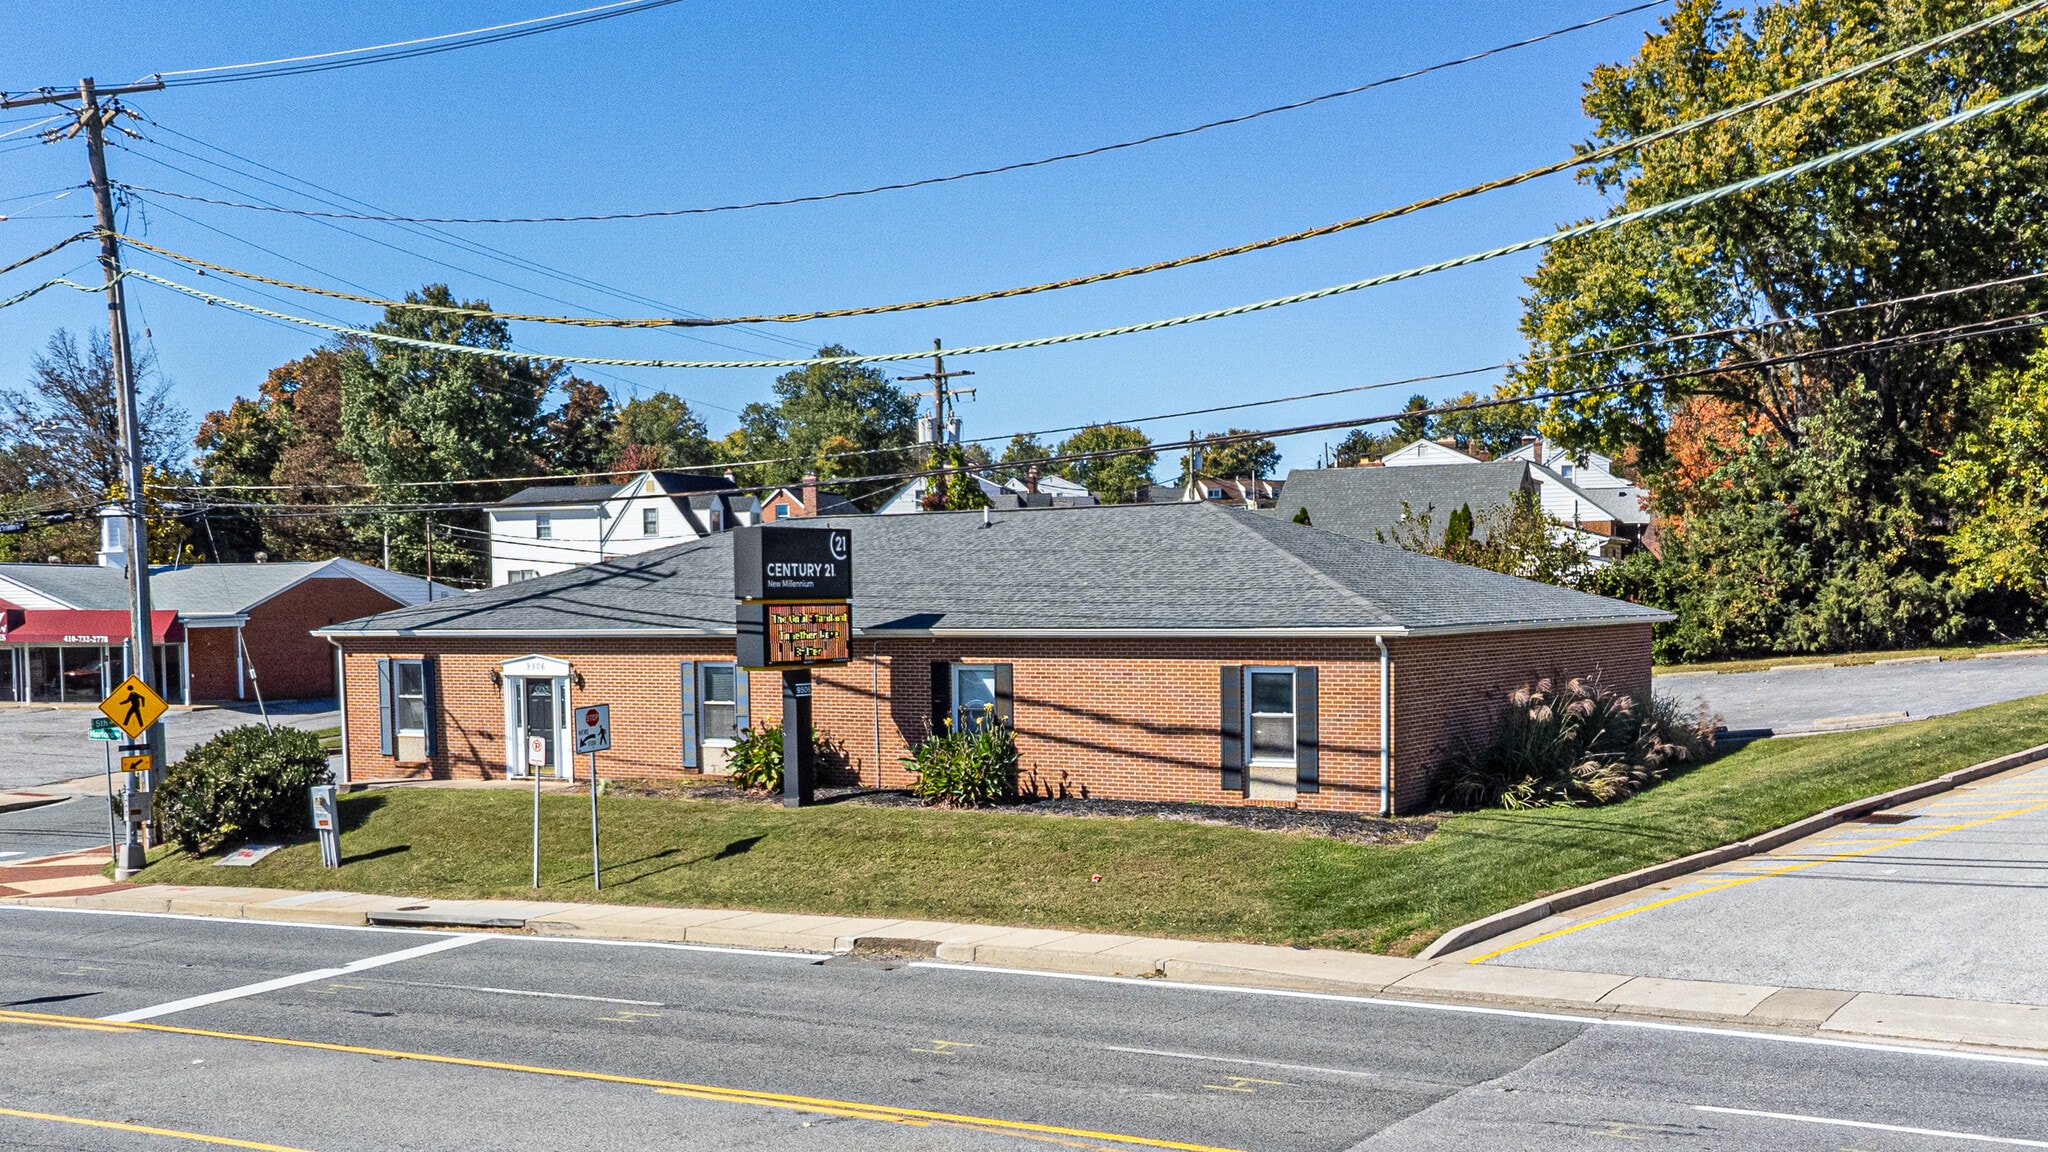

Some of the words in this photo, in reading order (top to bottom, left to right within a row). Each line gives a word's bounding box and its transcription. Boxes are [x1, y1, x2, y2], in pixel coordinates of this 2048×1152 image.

[767, 563, 822, 577] CENTURY
[824, 564, 835, 577] 21
[782, 580, 814, 588] Millennium
[526, 662, 546, 671] 9506
[95, 719, 109, 728] 5th
